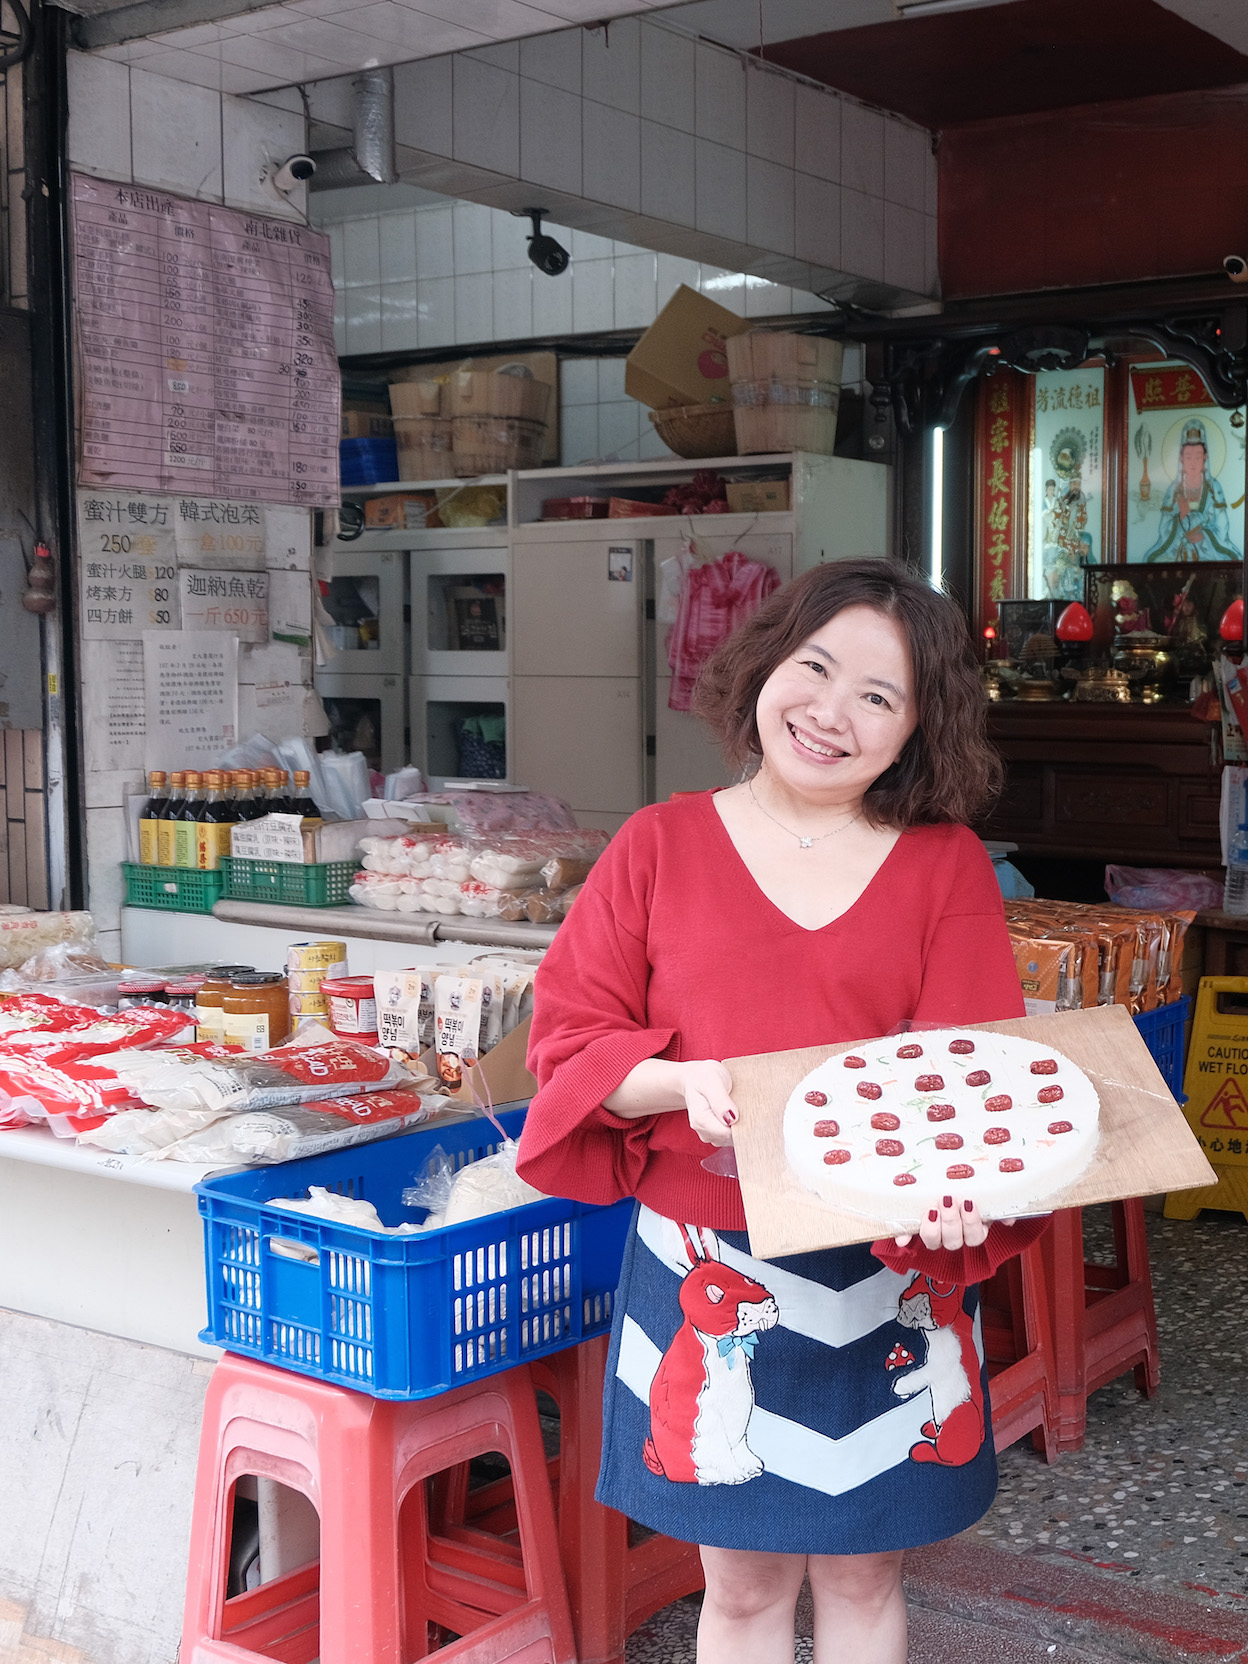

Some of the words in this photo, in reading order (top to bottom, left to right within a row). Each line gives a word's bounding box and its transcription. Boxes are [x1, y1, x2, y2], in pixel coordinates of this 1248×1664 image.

[114, 188, 176, 217] 本店出產
[244, 219, 302, 246] 南北雜貨
[172, 380, 187, 391] 850
[84, 499, 168, 525] 蜜汁雙方
[179, 500, 260, 525] 韓式泡菜
[100, 534, 131, 553] 250
[86, 563, 147, 580] 蜜汁火腿
[86, 586, 133, 601] 烤素方
[187, 575, 265, 599] 迦納魚乾
[87, 608, 133, 624] 四方餅
[186, 606, 268, 626] 一斤650元
[1198, 1061, 1224, 1074] WET
